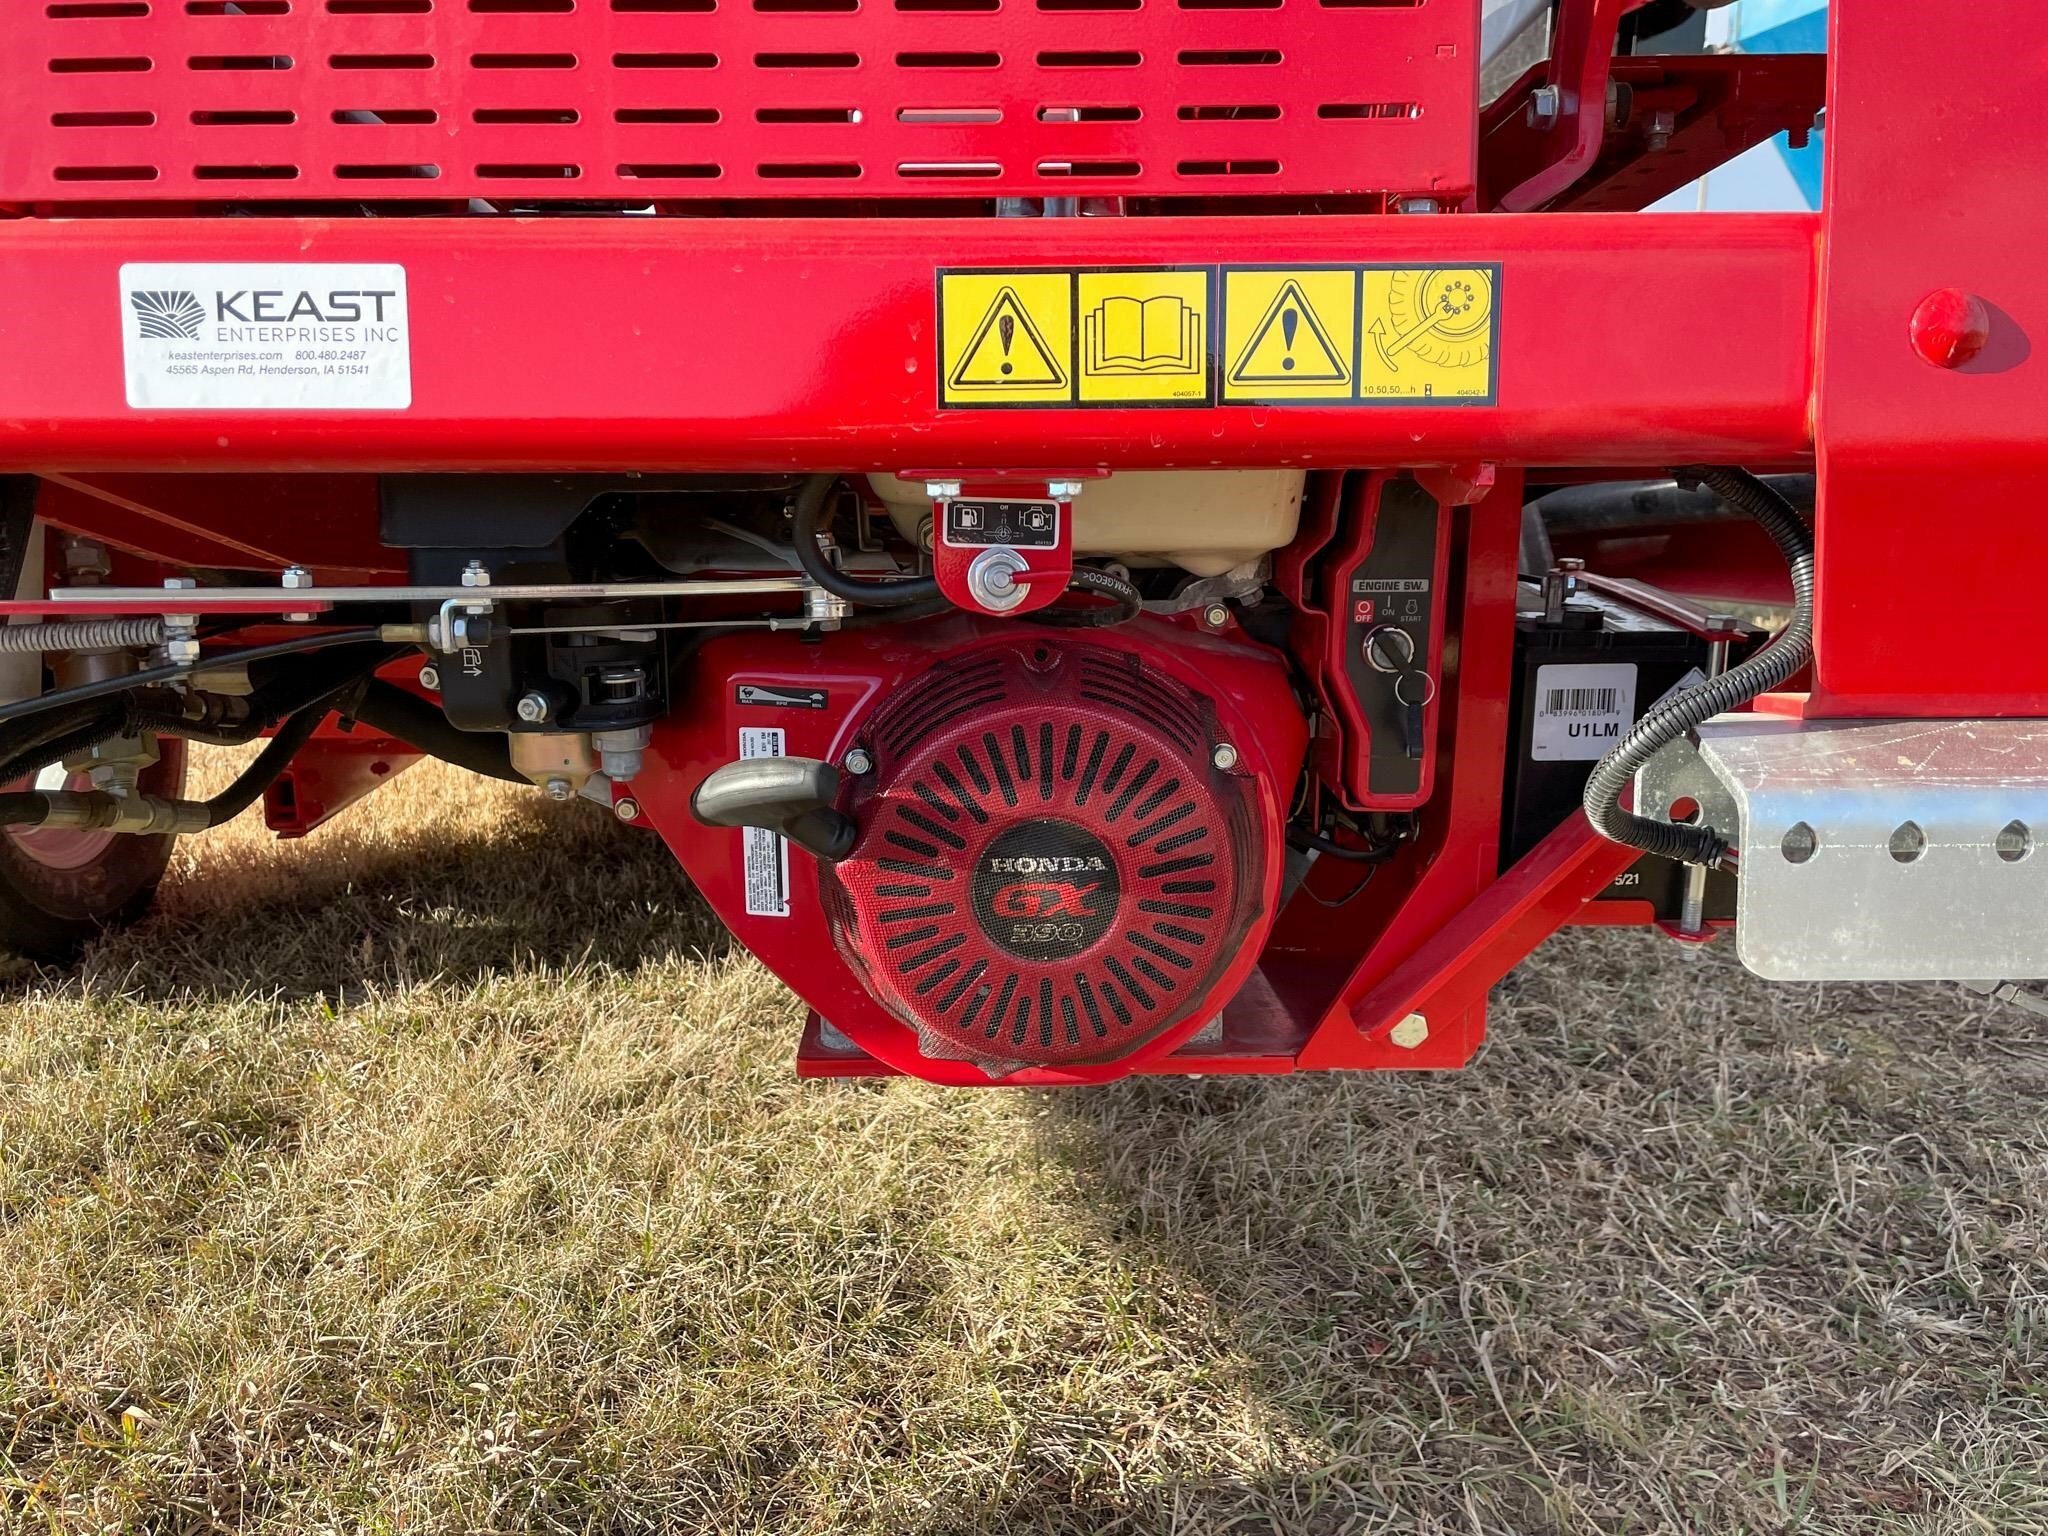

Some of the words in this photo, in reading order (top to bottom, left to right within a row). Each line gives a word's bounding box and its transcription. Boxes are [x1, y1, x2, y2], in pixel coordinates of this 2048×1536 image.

[216, 290, 396, 322] KEAST
[217, 327, 356, 342] ENTERPRISES
[365, 327, 399, 342] INC
[168, 350, 283, 362] keastenterprises.com
[295, 350, 366, 360] 800.480.2487
[166, 365, 198, 375] 45565
[200, 365, 235, 376] Aspen
[238, 365, 256, 375] Rd,
[259, 365, 320, 375] Henderson,
[323, 365, 335, 374] IA
[337, 365, 369, 374] 51541
[1358, 581, 1400, 591] ENGINE
[1403, 581, 1424, 591] SW.
[1382, 608, 1395, 616] ON
[1568, 723, 1619, 737] U1LM
[990, 856, 1107, 873] HONDA
[992, 882, 1101, 917] GX
[1010, 923, 1084, 942] 390
